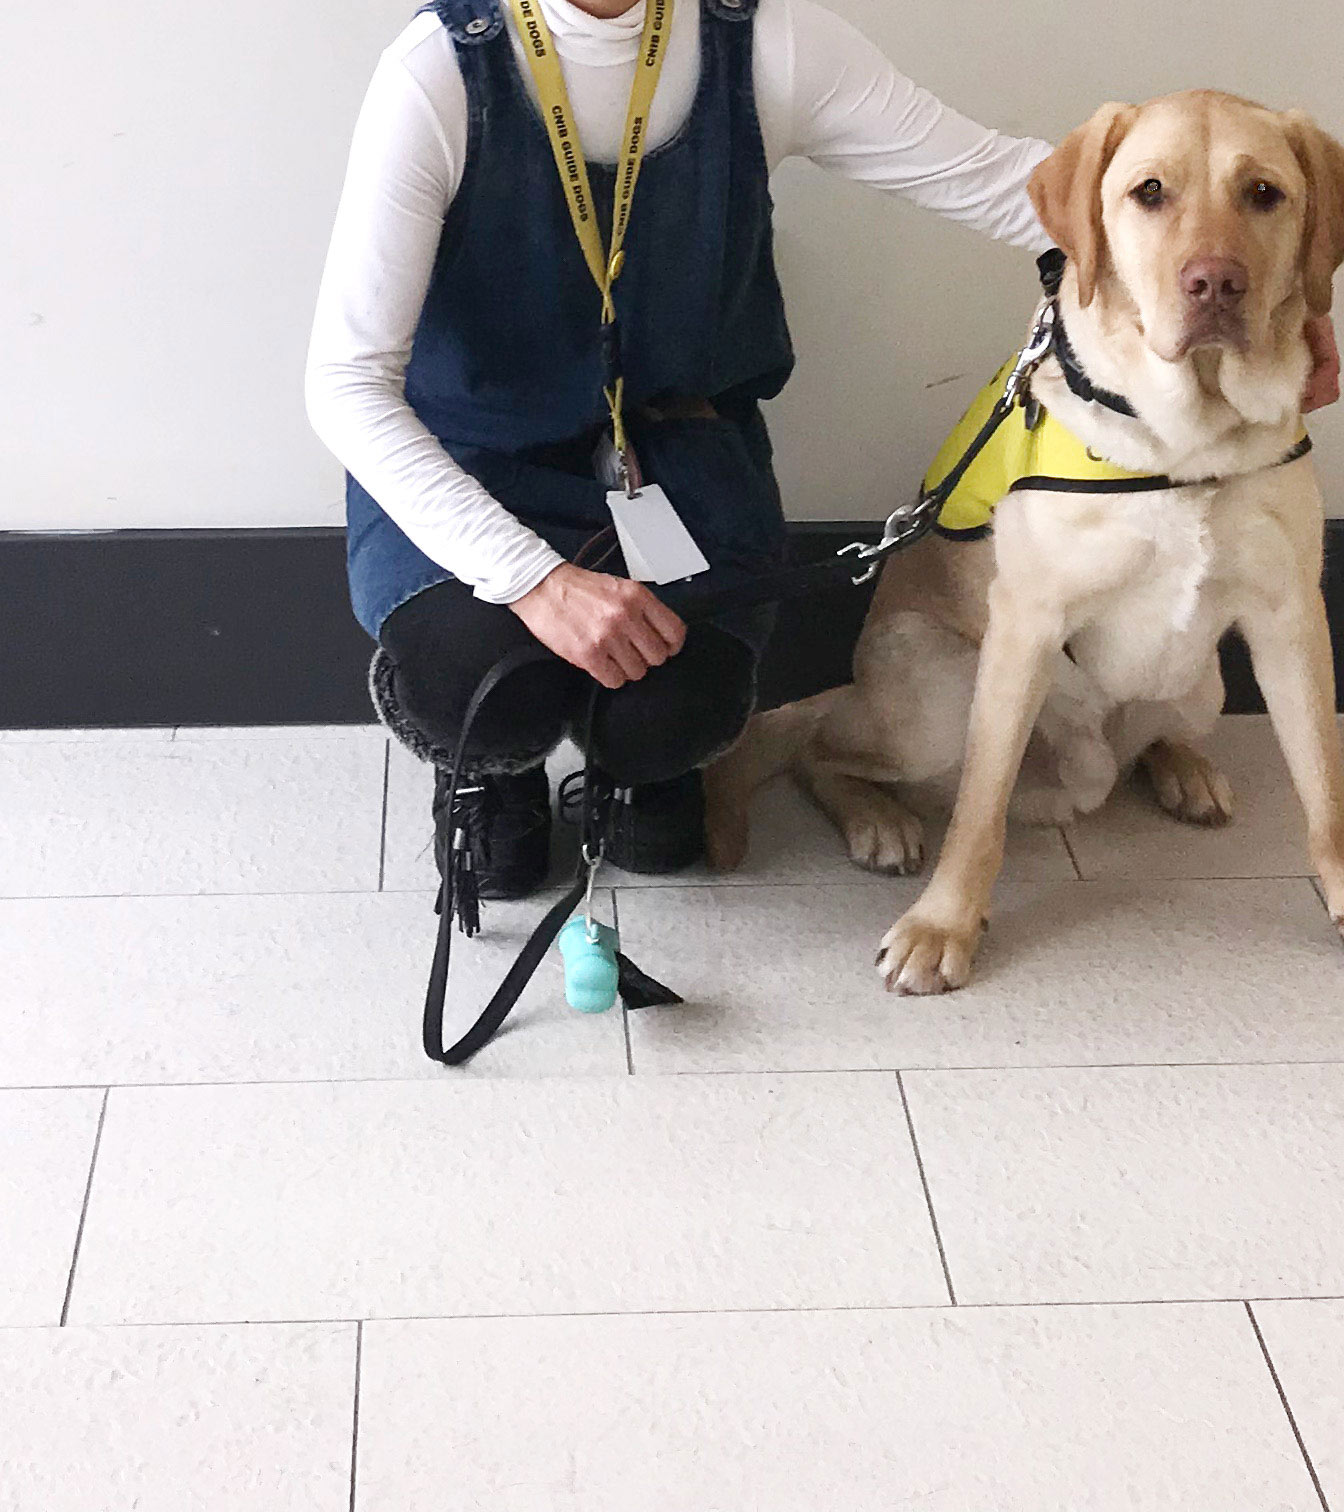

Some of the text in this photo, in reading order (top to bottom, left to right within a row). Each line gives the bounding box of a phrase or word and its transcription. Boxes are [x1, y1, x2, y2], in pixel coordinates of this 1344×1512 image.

[526, 20, 547, 57] DOGS
[645, 34, 660, 67] CNIB
[551, 105, 588, 222] CNIB GUIDE DOGS
[622, 158, 636, 200] GUIDE
[629, 117, 642, 154] DOGS
